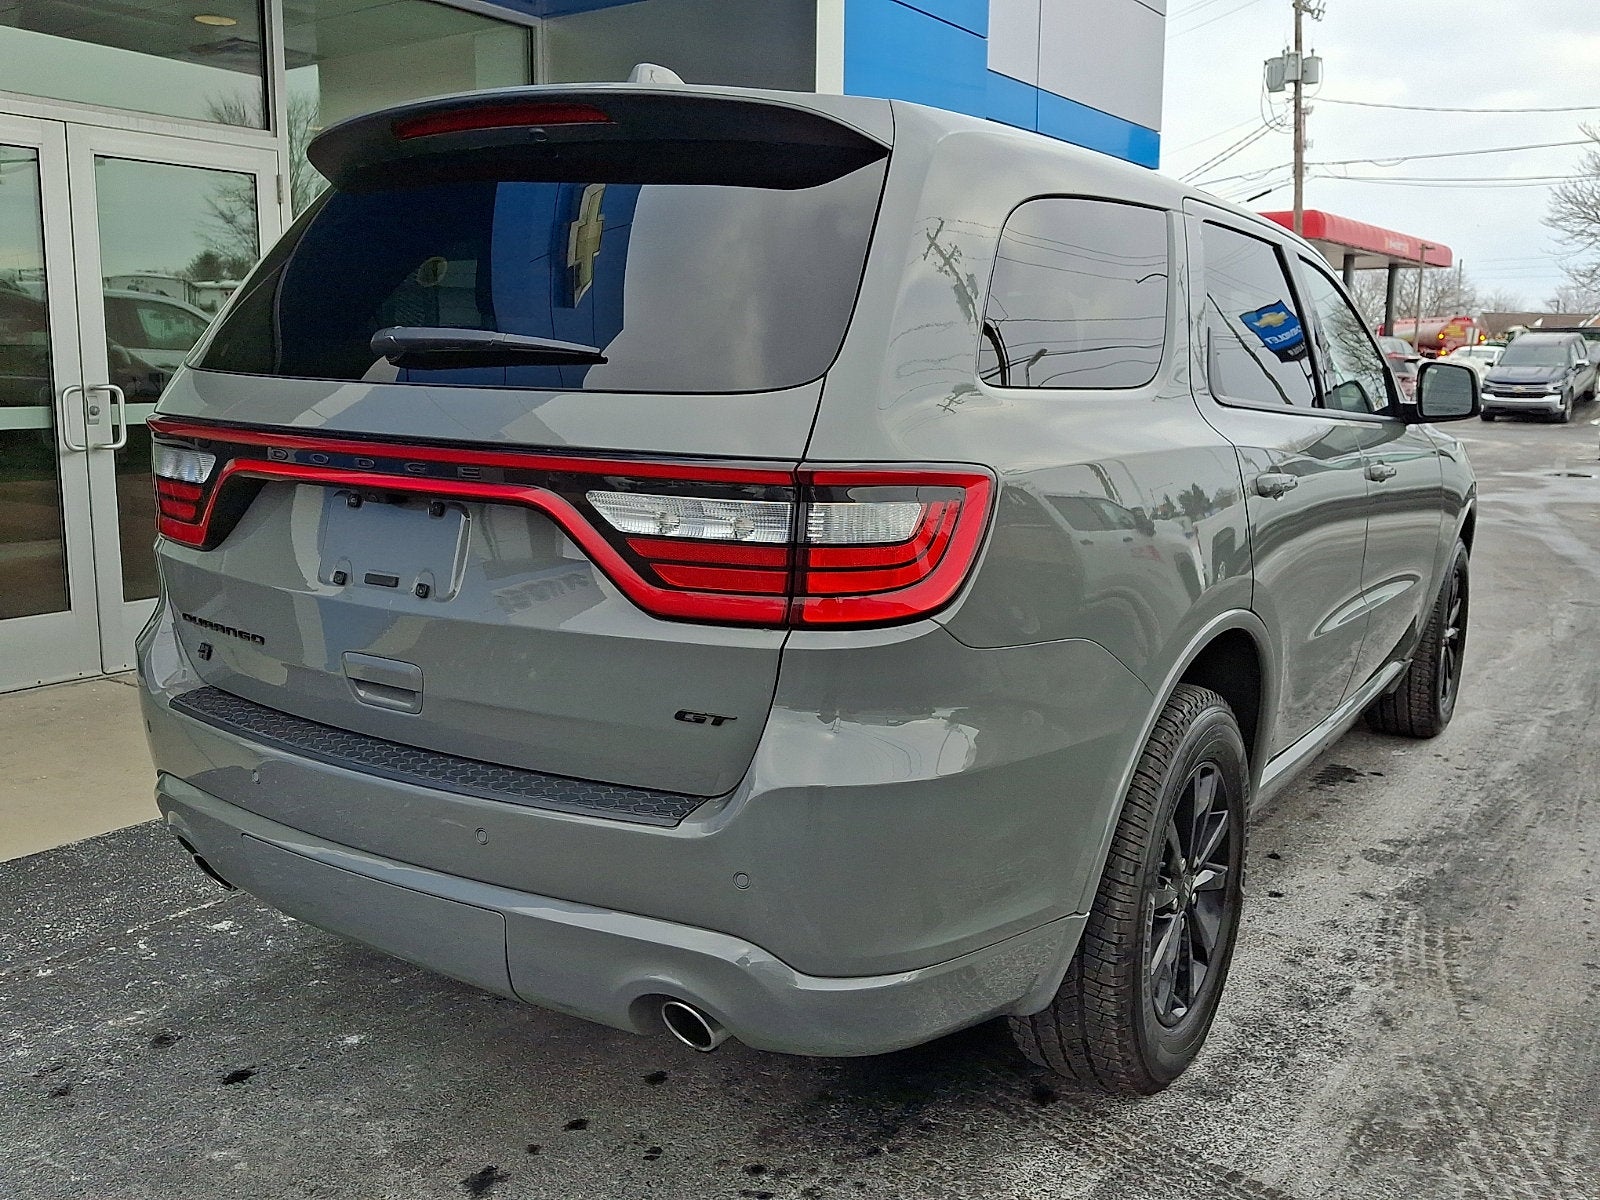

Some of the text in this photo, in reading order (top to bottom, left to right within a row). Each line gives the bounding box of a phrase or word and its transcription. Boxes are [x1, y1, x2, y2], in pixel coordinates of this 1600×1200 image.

[267, 446, 482, 480] DODGE
[181, 612, 265, 645] DURANGO
[674, 709, 738, 726] GT
